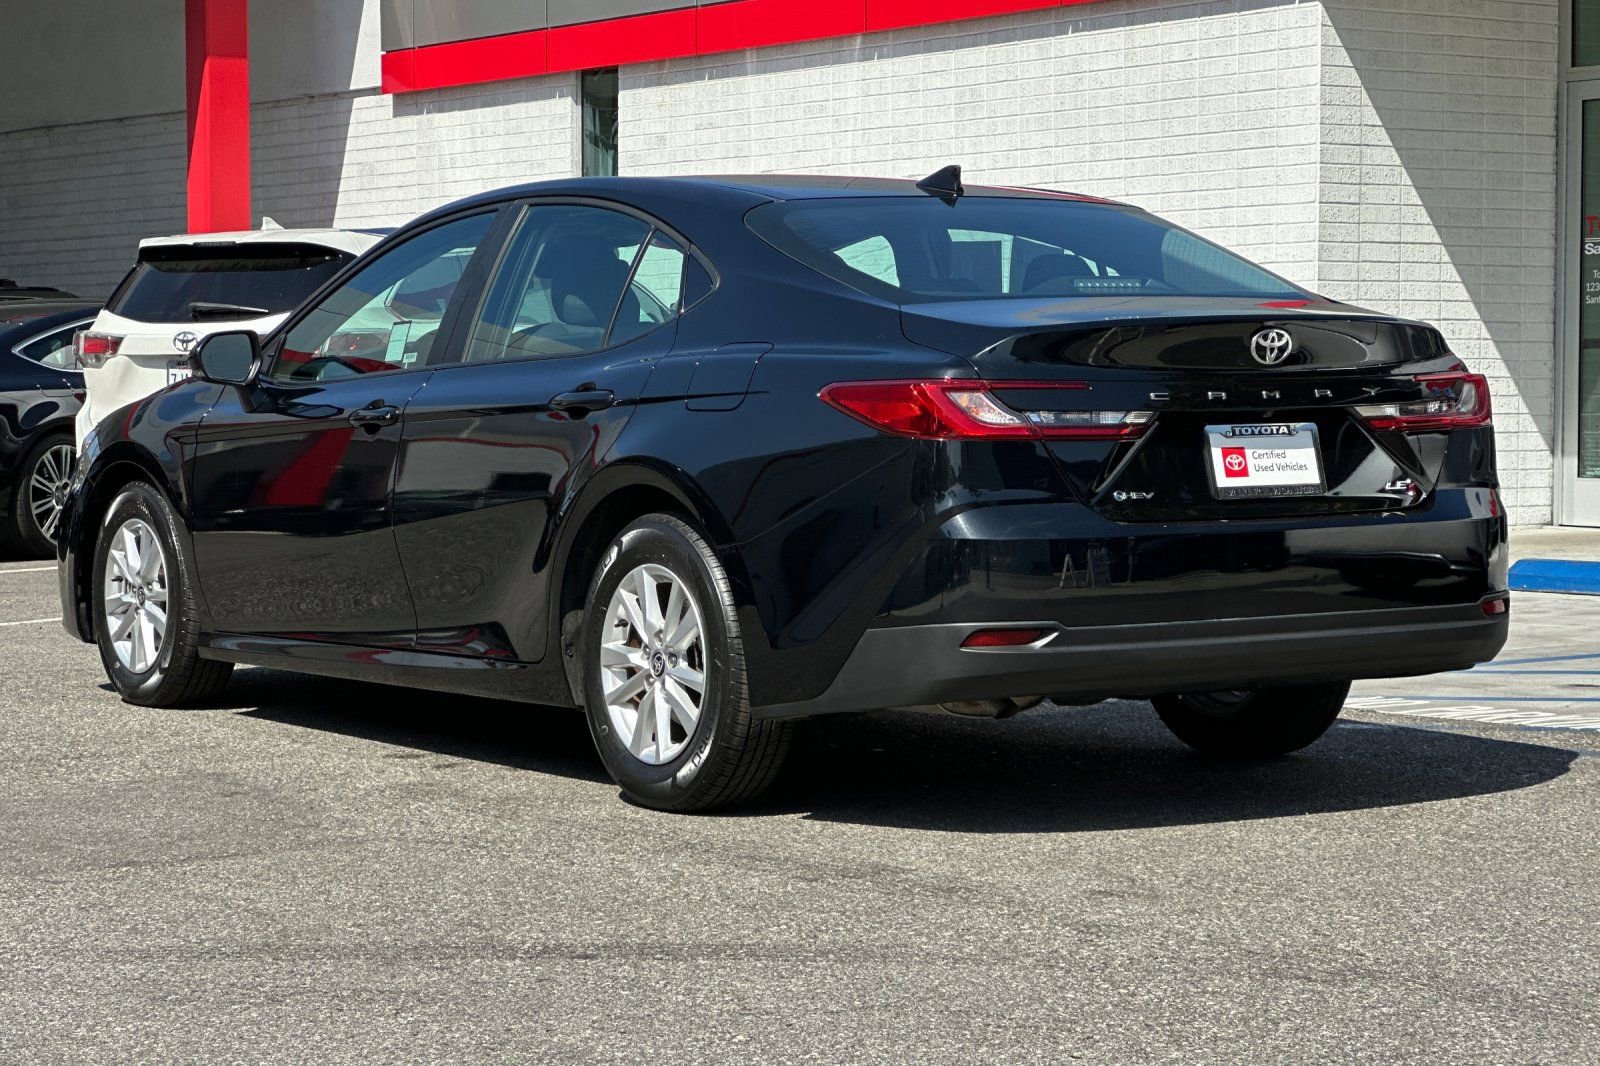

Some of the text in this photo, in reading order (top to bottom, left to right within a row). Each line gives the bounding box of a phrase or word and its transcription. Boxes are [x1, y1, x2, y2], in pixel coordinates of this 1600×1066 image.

[1149, 386, 1381, 401] CAMRY
[1233, 425, 1289, 436] TOYOTA
[1252, 450, 1287, 460] Certified
[1253, 462, 1308, 472] Used Vehicles
